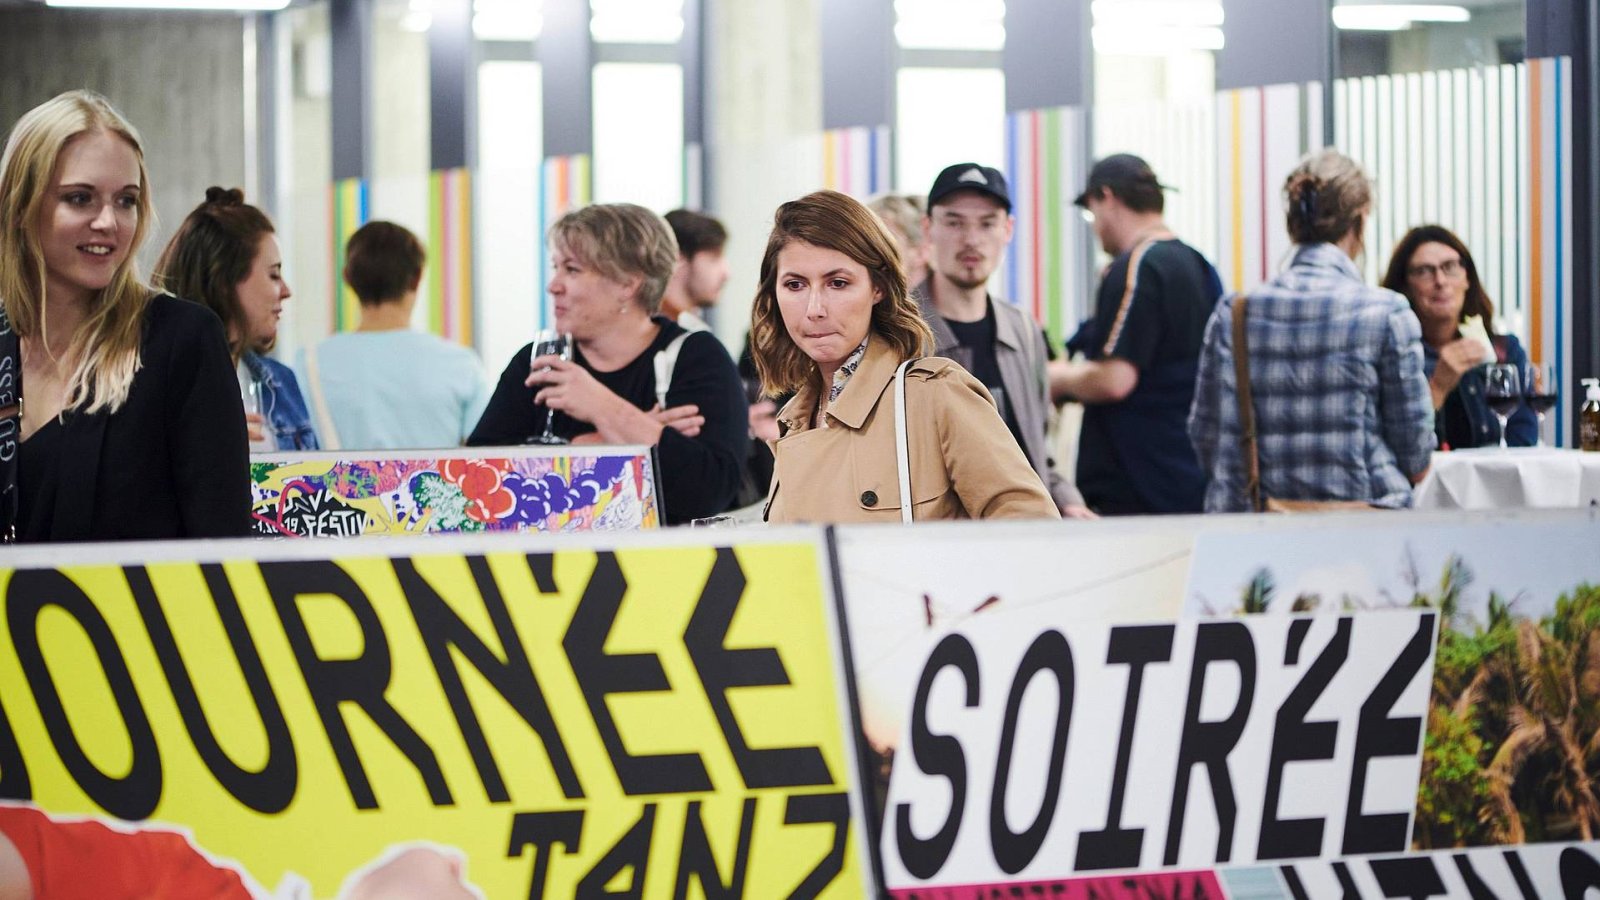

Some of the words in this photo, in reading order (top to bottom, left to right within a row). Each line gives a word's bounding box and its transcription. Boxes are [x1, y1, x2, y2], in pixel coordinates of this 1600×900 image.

[0, 355, 16, 462] GUESS
[0, 547, 835, 822] OURNÉE
[897, 613, 1436, 880] SOIRÉE
